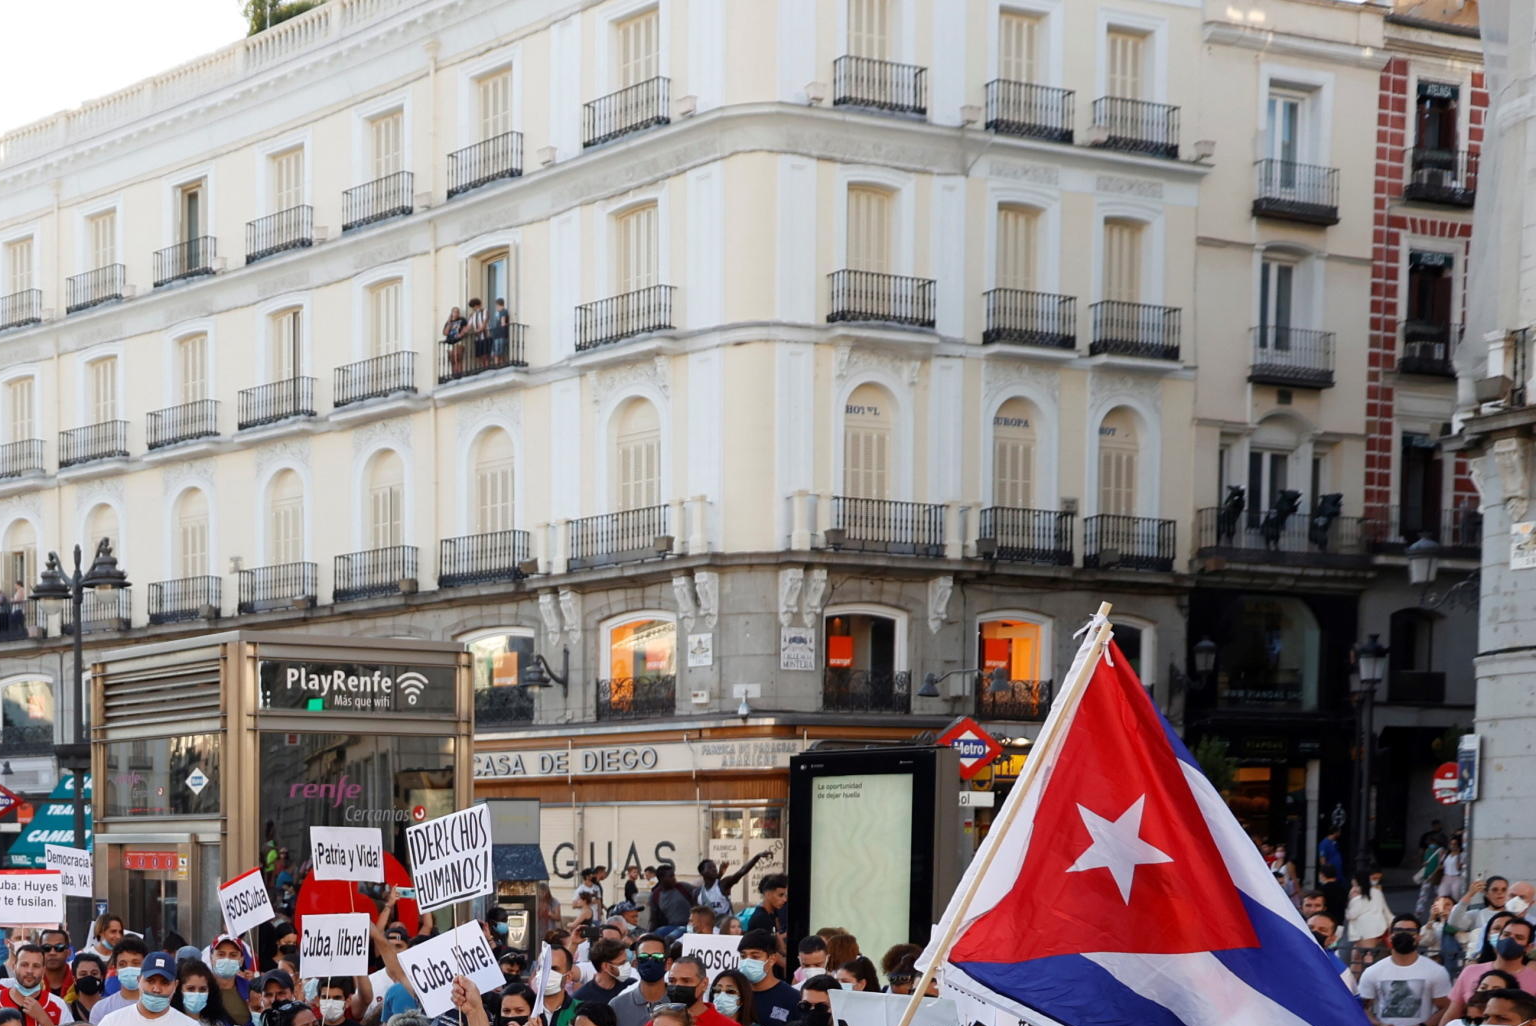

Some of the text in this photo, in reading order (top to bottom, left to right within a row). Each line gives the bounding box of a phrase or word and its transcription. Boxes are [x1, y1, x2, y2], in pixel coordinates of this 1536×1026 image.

[286, 668, 392, 696] PlayRenfe
[334, 694, 390, 708] Más que wifi
[954, 741, 984, 756] Metro
[473, 746, 658, 777] CASA DE DIEGO
[289, 775, 363, 808] renfe
[826, 783, 863, 792] oportunidad
[46, 849, 90, 869] Democracia
[314, 842, 381, 872] ¡Patria y Vida!
[24, 880, 59, 894] Huyes
[61, 875, 91, 889] uba, YA!
[416, 851, 489, 905] HUMANOS!
[3, 896, 15, 906] te
[16, 895, 57, 908] fusilan.
[303, 928, 368, 961] Cuba, libre!
[410, 936, 494, 995] Cuba, libre!
[688, 948, 740, 971] #SOSCu
